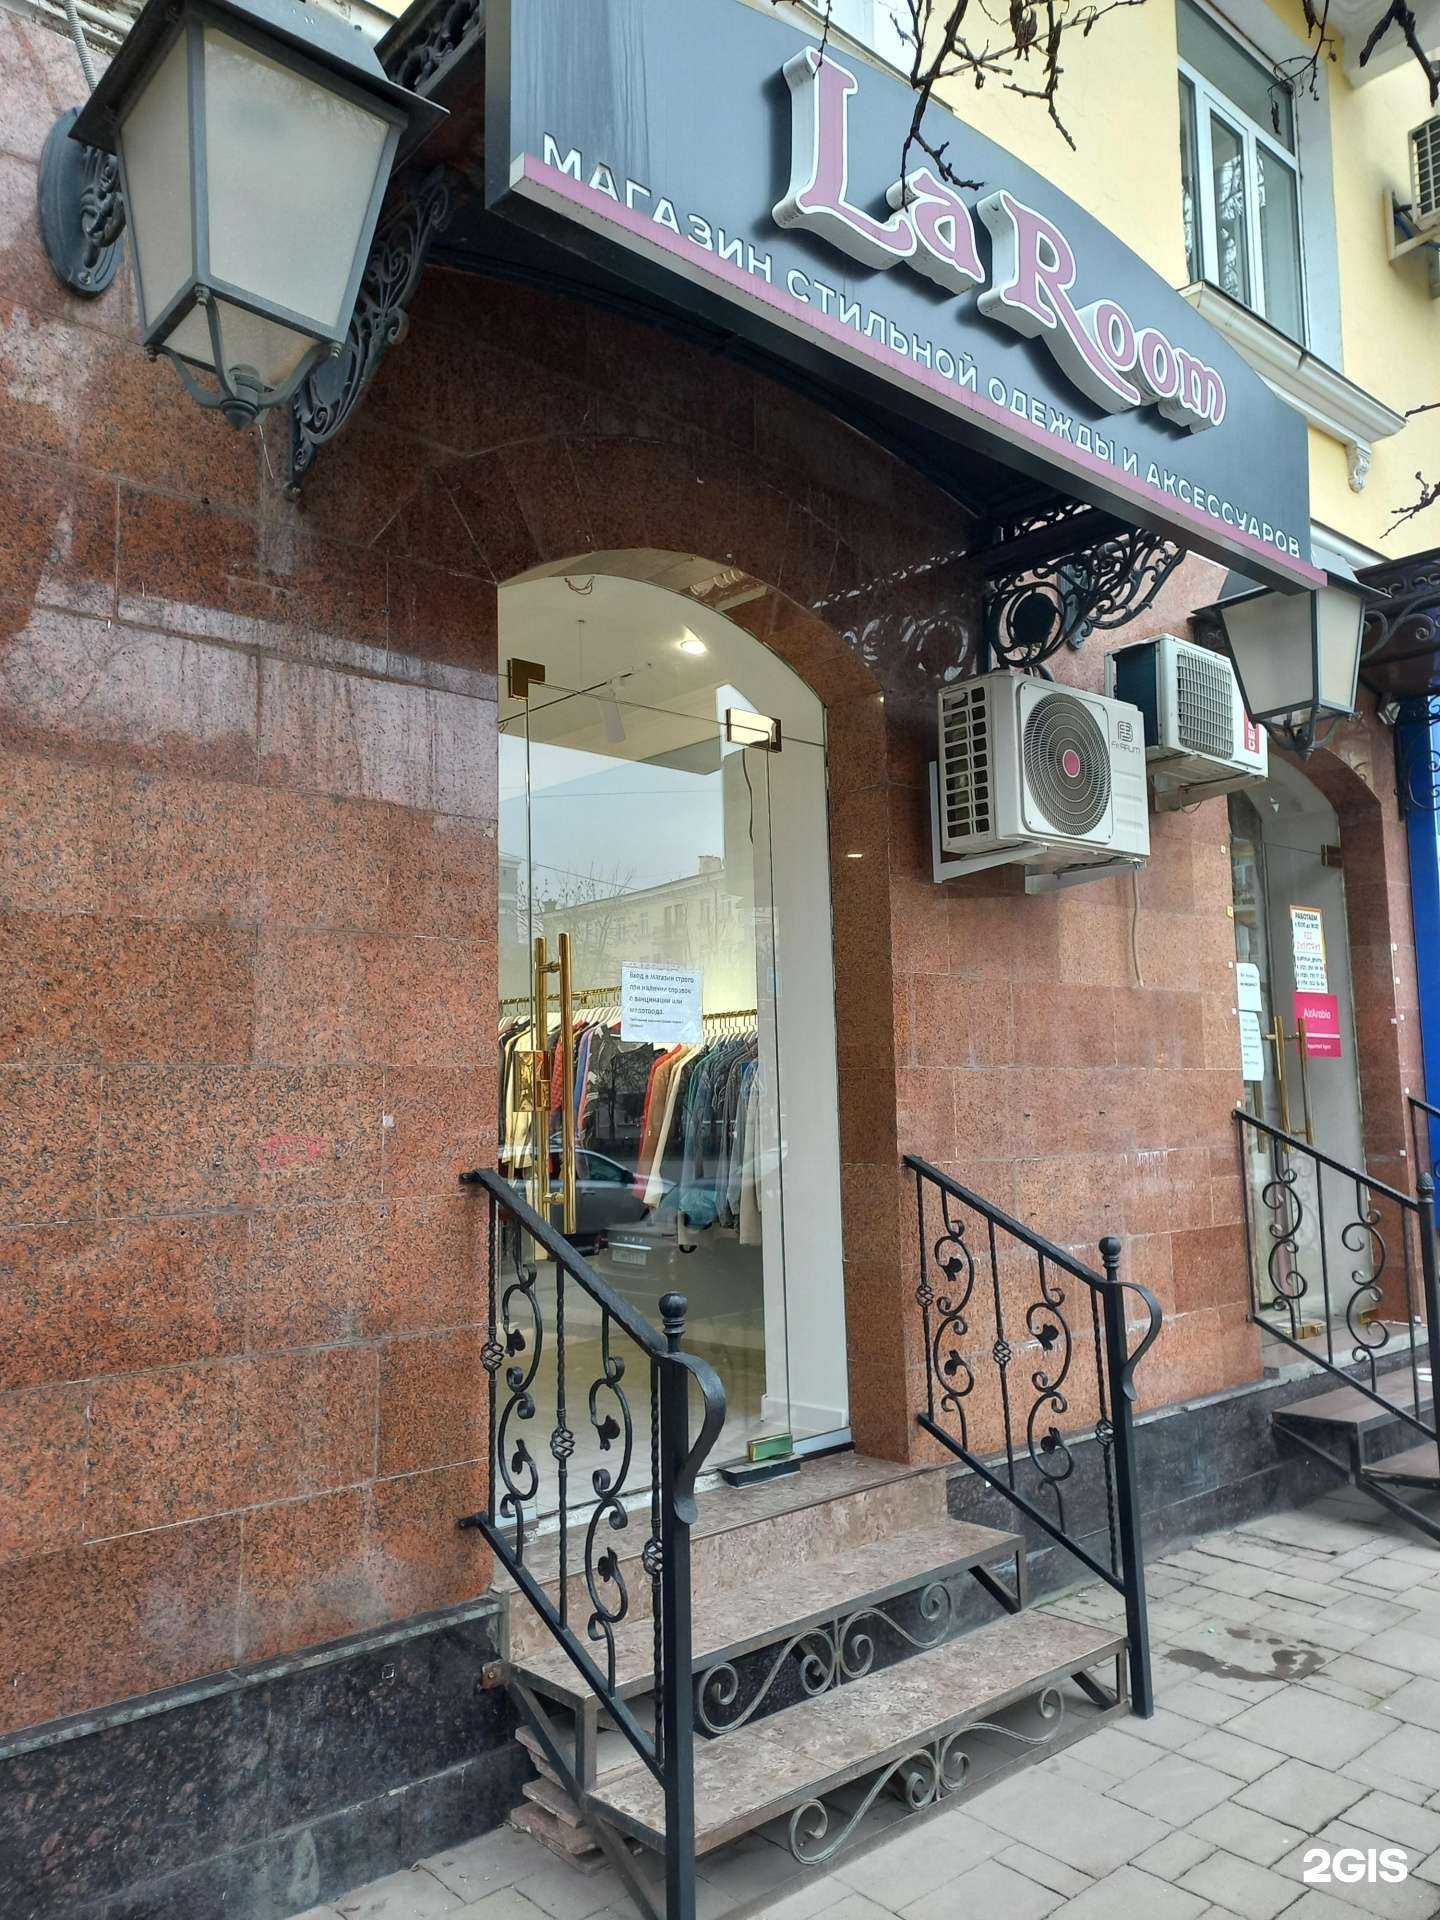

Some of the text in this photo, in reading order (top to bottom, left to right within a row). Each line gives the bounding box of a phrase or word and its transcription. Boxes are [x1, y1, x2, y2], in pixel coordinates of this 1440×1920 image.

[543, 132, 1301, 559] МАГАЗИН СТИЛЬНОЙ ОДЕЖДЫ И АКСЕССУАРОВ
